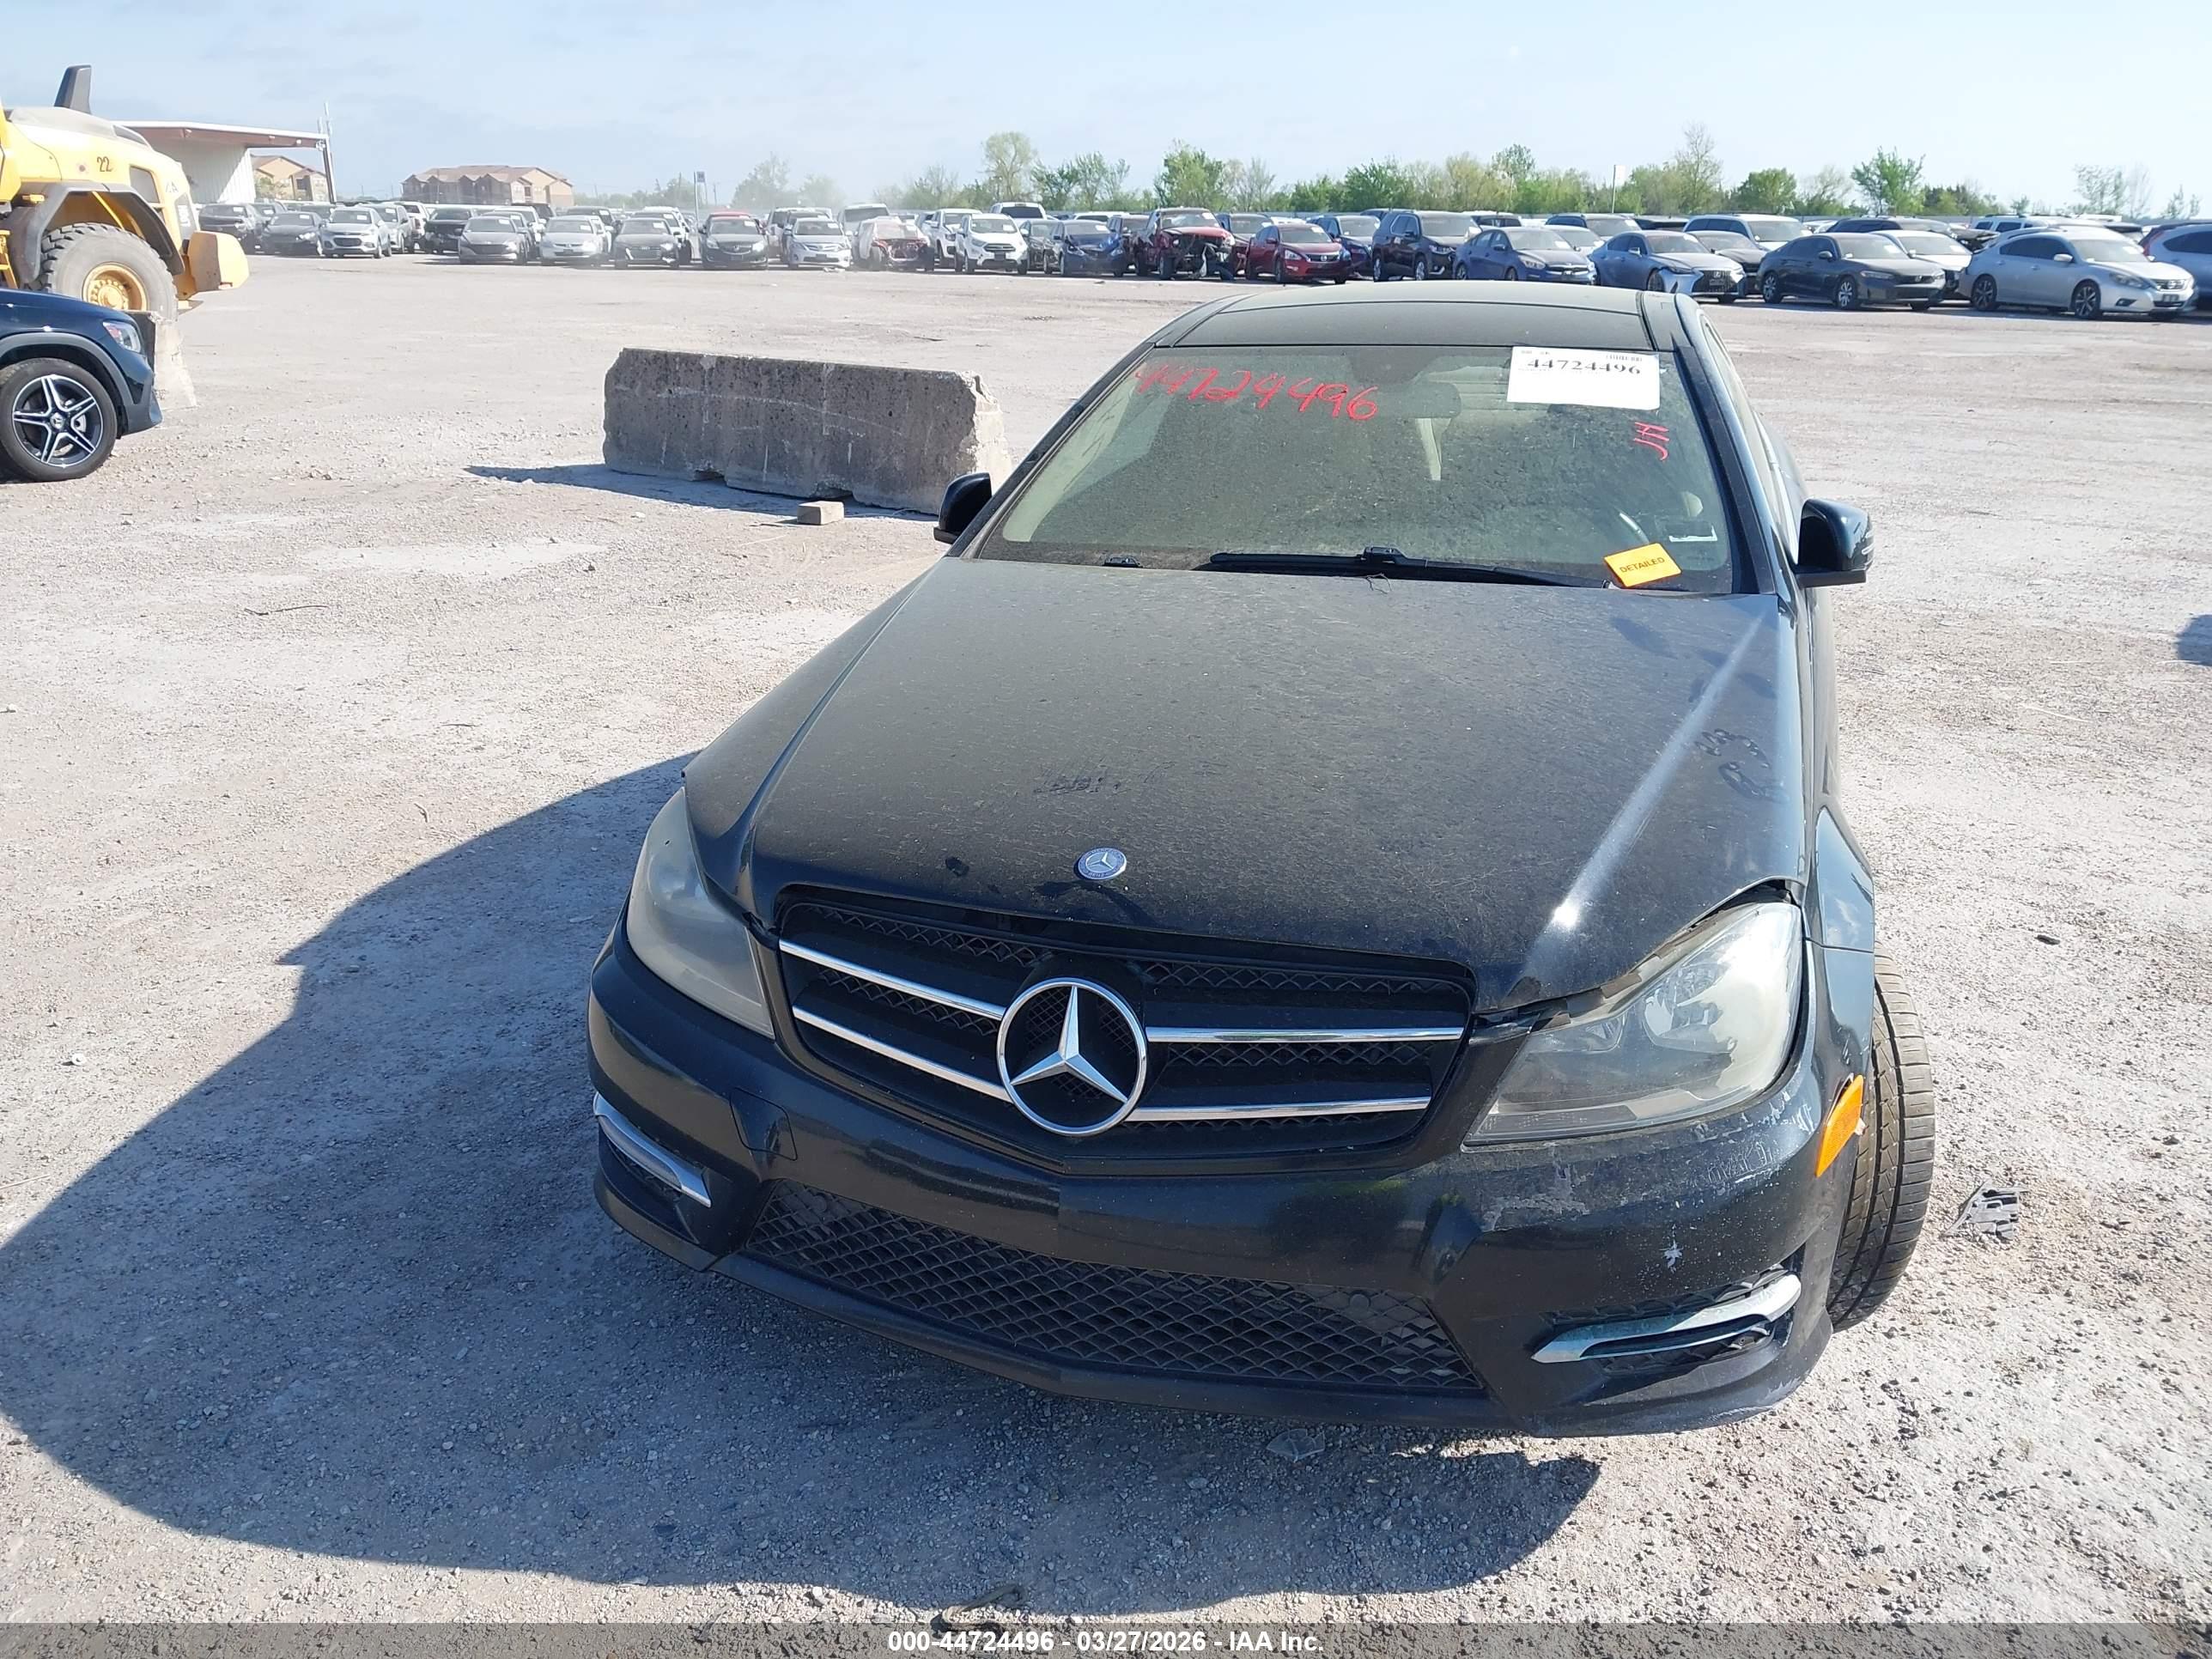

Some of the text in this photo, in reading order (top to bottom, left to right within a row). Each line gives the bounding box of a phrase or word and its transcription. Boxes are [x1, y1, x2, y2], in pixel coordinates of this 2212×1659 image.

[96, 155, 113, 173] 22
[1527, 358, 1641, 375] 44724496
[1134, 364, 1378, 421] 44724496
[1619, 556, 1665, 573] DETAILED
